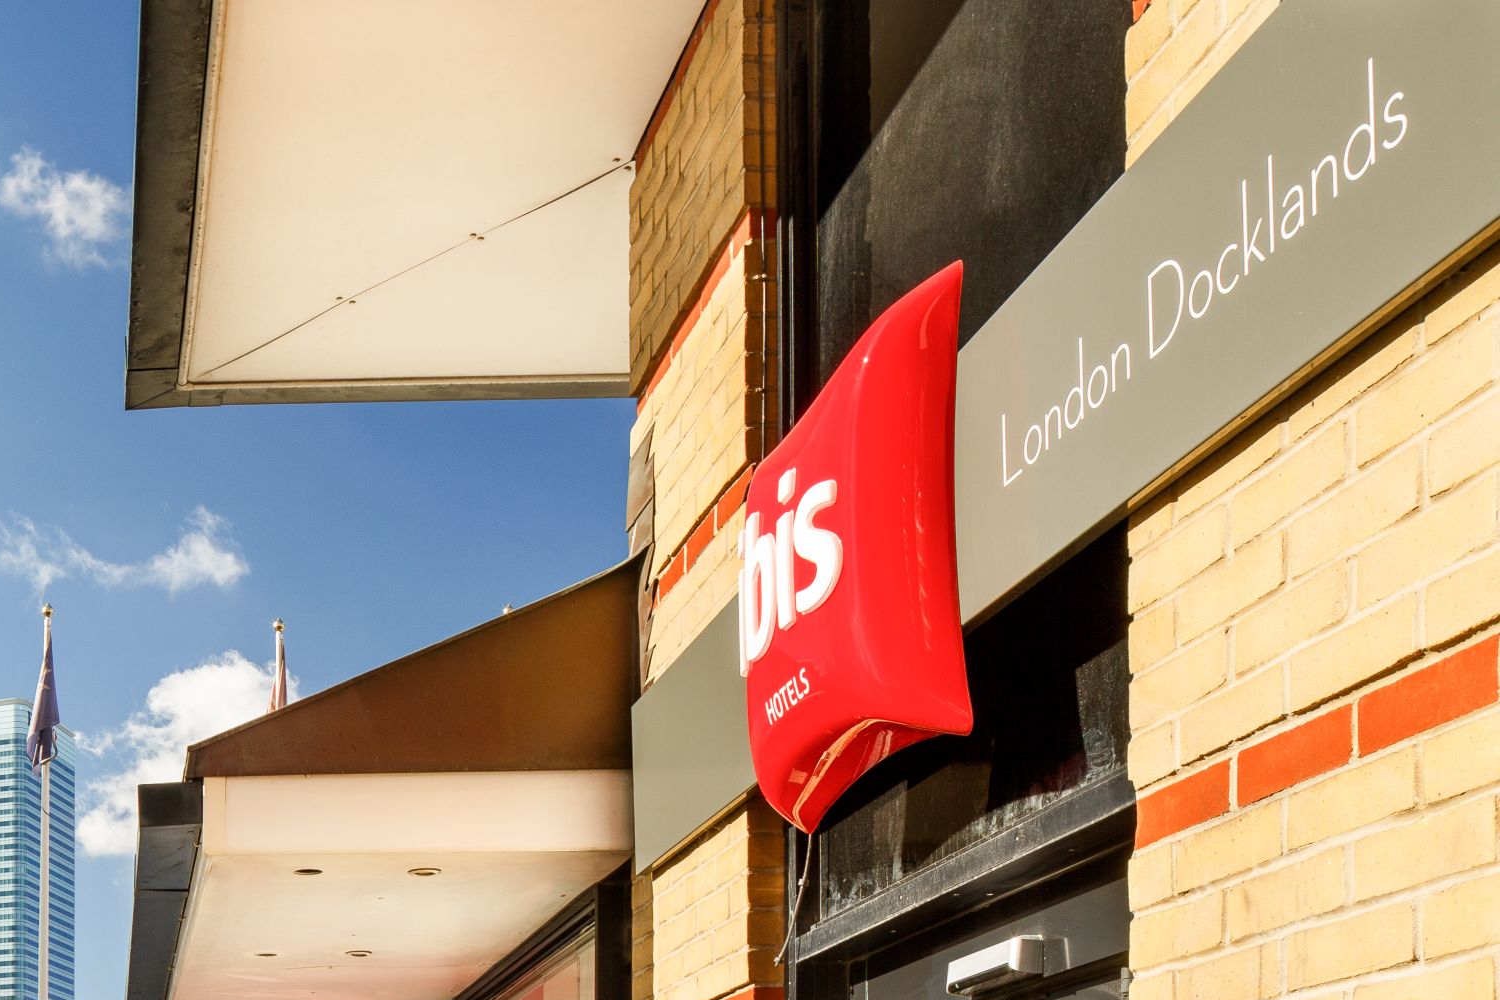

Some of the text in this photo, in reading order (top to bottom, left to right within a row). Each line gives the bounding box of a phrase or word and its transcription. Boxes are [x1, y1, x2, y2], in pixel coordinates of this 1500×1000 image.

[1001, 57, 1409, 488] London Docklands
[738, 467, 843, 677] ibis
[765, 668, 810, 726] HOTELS
